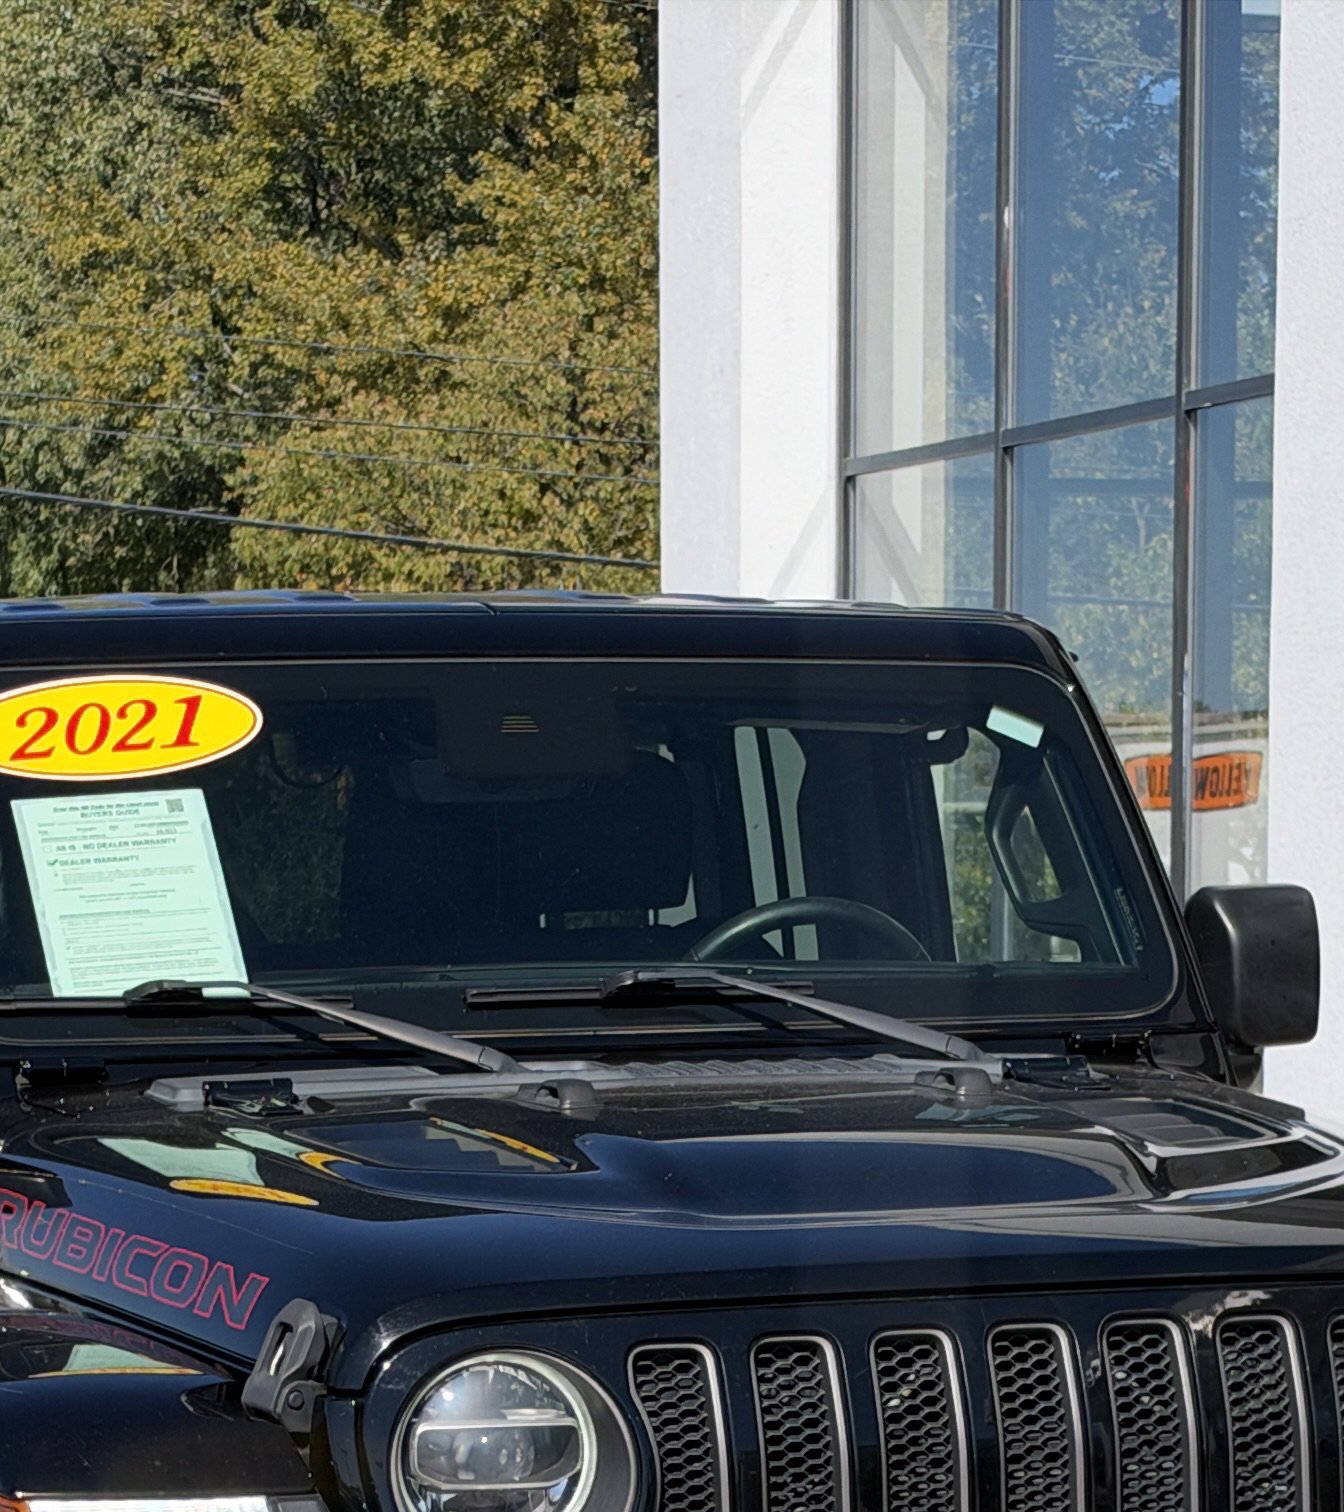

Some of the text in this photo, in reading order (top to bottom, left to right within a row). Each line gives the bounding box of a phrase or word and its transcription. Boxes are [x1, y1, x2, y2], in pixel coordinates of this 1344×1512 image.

[10, 695, 203, 761] 2021
[115, 808, 140, 816] GUIDE
[83, 842, 95, 850] NO
[96, 840, 129, 849] DEALER
[131, 837, 177, 847] WARRANTY
[58, 854, 139, 866] DEALER WARRANTY
